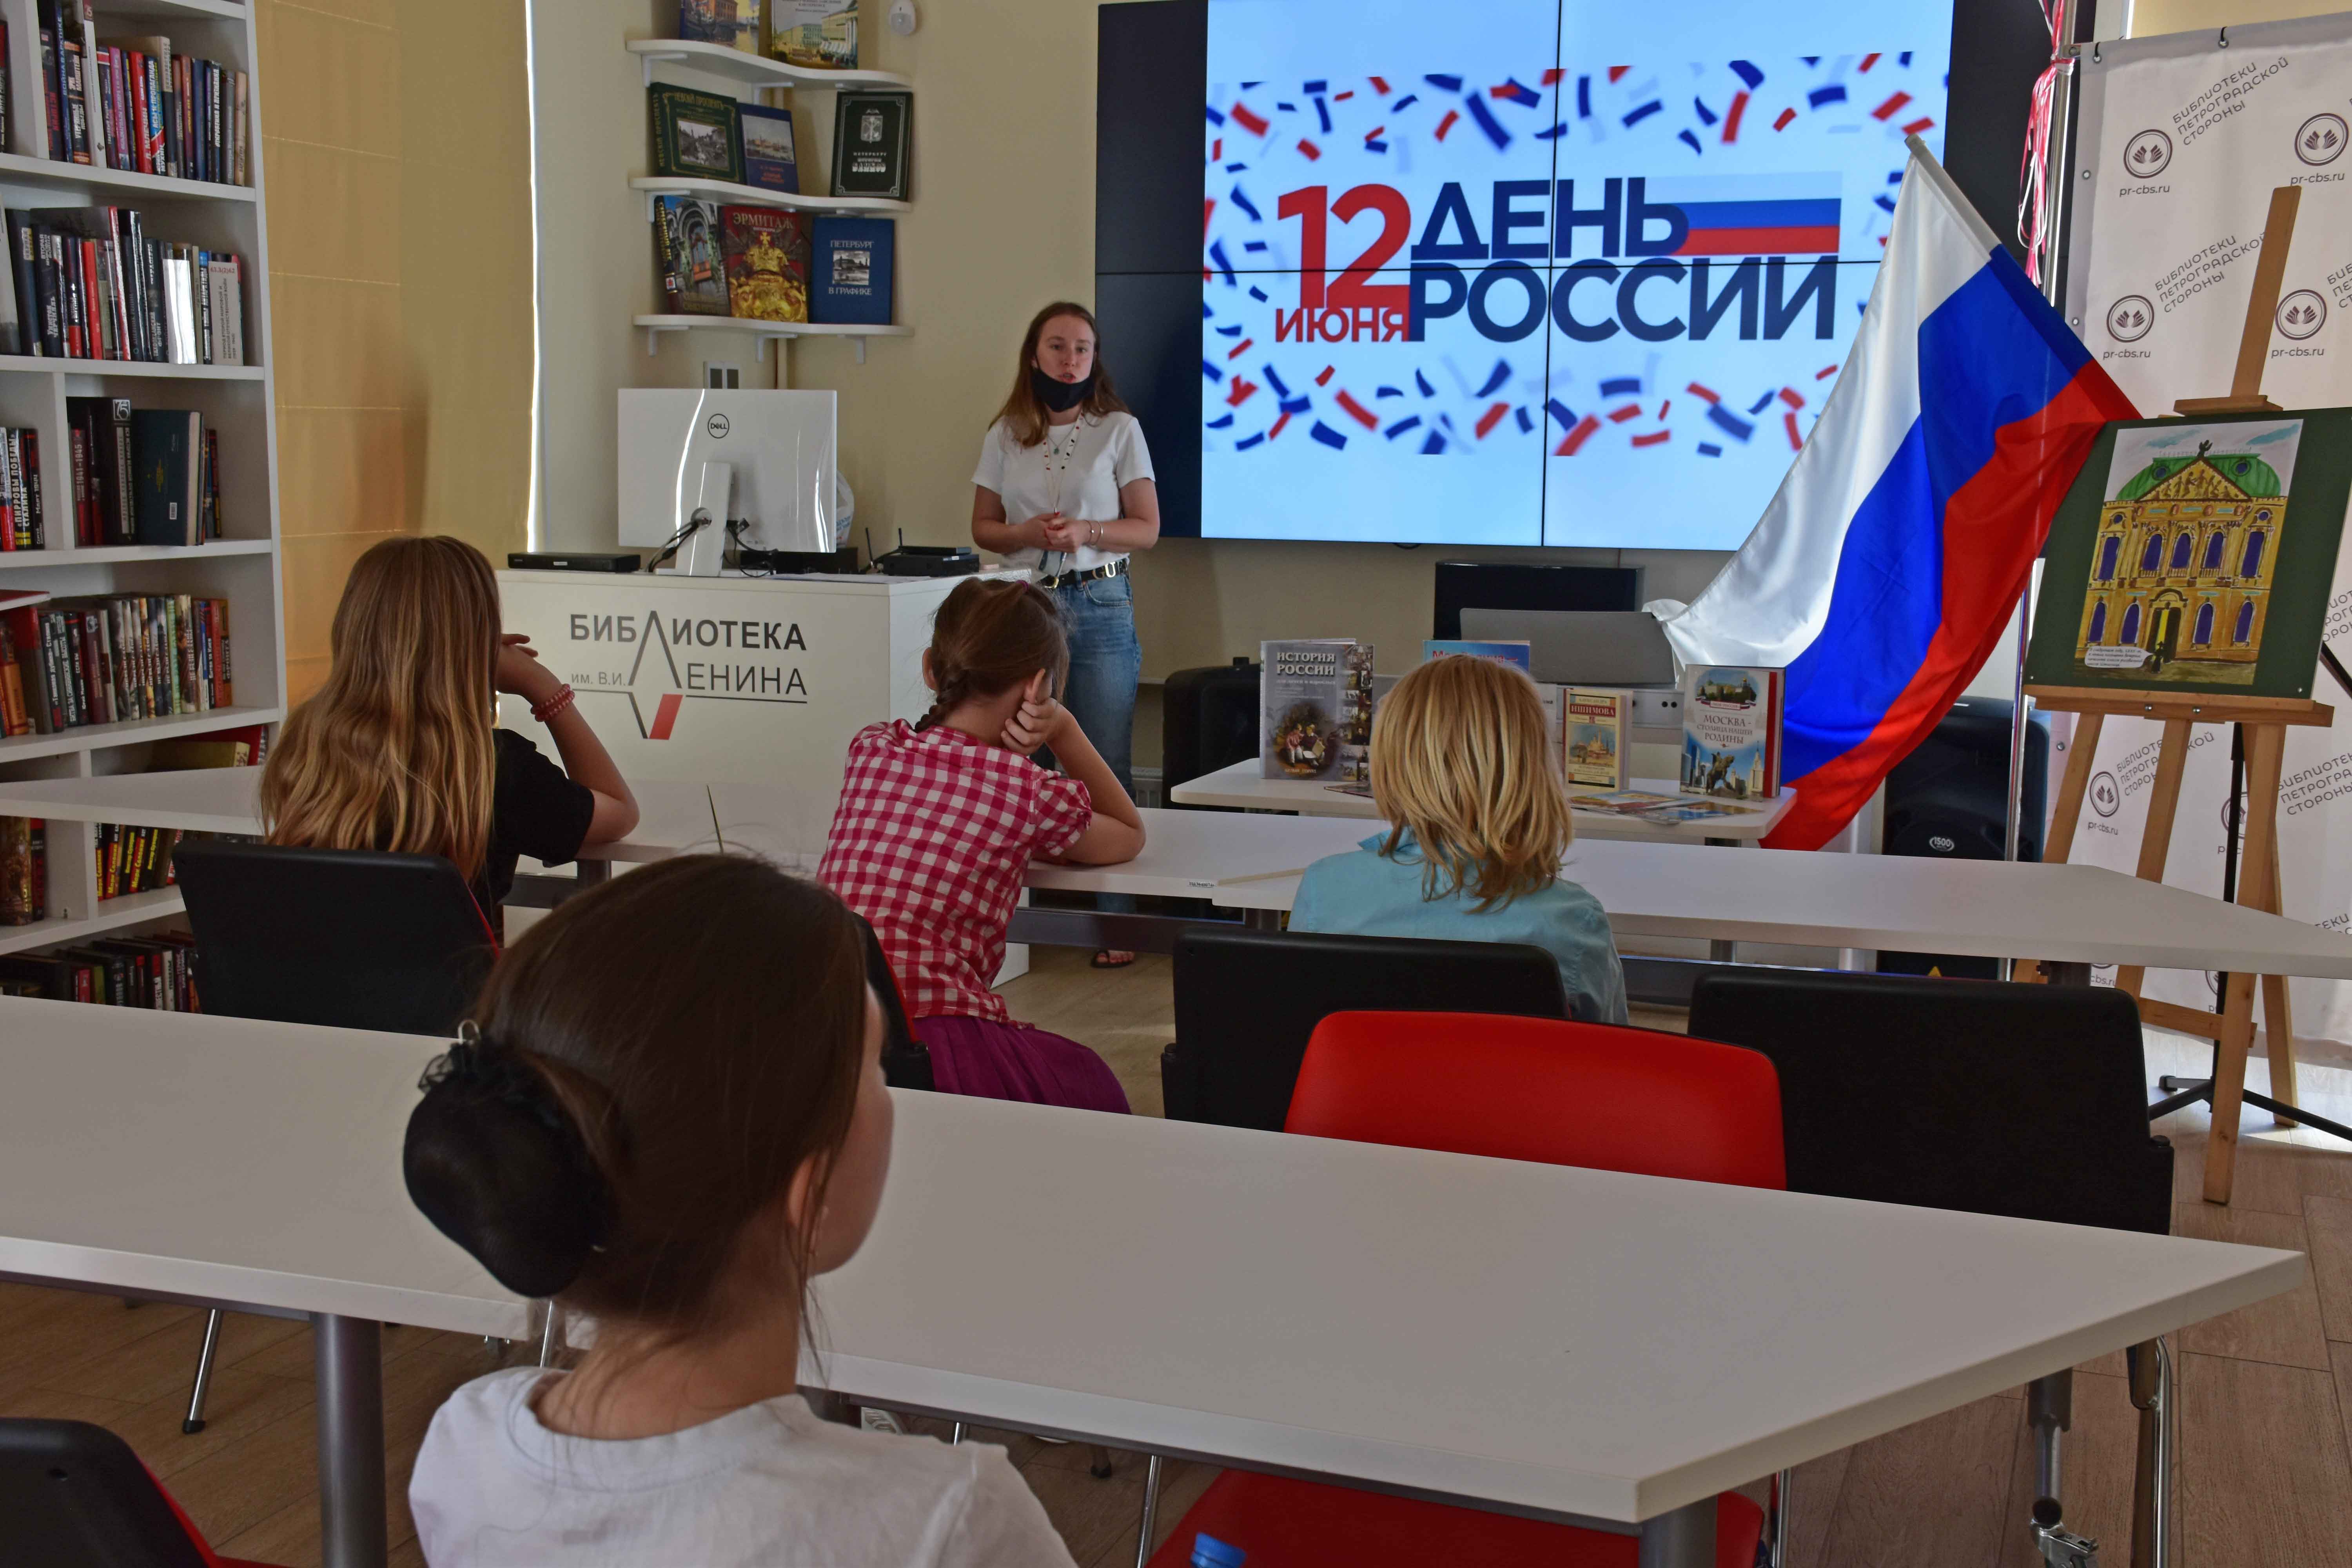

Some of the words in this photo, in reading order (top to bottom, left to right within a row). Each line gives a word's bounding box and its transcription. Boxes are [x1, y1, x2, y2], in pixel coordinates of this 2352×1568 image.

[2173, 62, 2257, 124] БИБЛИОТЕКИ
[2178, 57, 2289, 135] ПЕТРОГРАДСКОЙ
[2183, 102, 2246, 145] СТОРОНЫ
[2290, 172, 2345, 186] pr-cbs.ru
[2120, 184, 2171, 197] pr-cbs.ru
[733, 213, 794, 229] ЭРМИТАЖ
[1410, 177, 1689, 260] ДЕНЬ
[830, 240, 874, 249] ПЕТЕРБУРГ
[1278, 183, 1411, 309] 12
[2154, 235, 2237, 291] БИБЛИОТЕКИ
[1408, 255, 1838, 343] РОССИИ
[2163, 271, 2225, 314] СТОРОНЫ
[1276, 307, 1409, 343] ИЮНЯ
[2103, 349, 2151, 360] pr-cbs.ru
[2271, 347, 2325, 359] pr-cbs.ru
[12, 479, 22, 527] «ПИРРОВЫ
[1276, 652, 1336, 662] ИСТОРИЯ
[571, 672, 593, 684] им.
[598, 672, 626, 686] В.И.
[1276, 664, 1335, 676] РОССИИ
[1571, 705, 1615, 715] ИШИМОВА
[1697, 724, 1728, 733] СТОЛИЦА
[1704, 715, 1746, 727] МОСКВА
[1705, 732, 1744, 744] РОДИНЫ
[2117, 739, 2163, 772] БИБЛИОТЕ
[2279, 753, 2352, 791] ИБЛИОТЕ
[2124, 772, 2156, 796] СТОРО
[2281, 769, 2352, 803] ПЕТРОГРА
[2088, 822, 2118, 835] pr-cbs.ru
